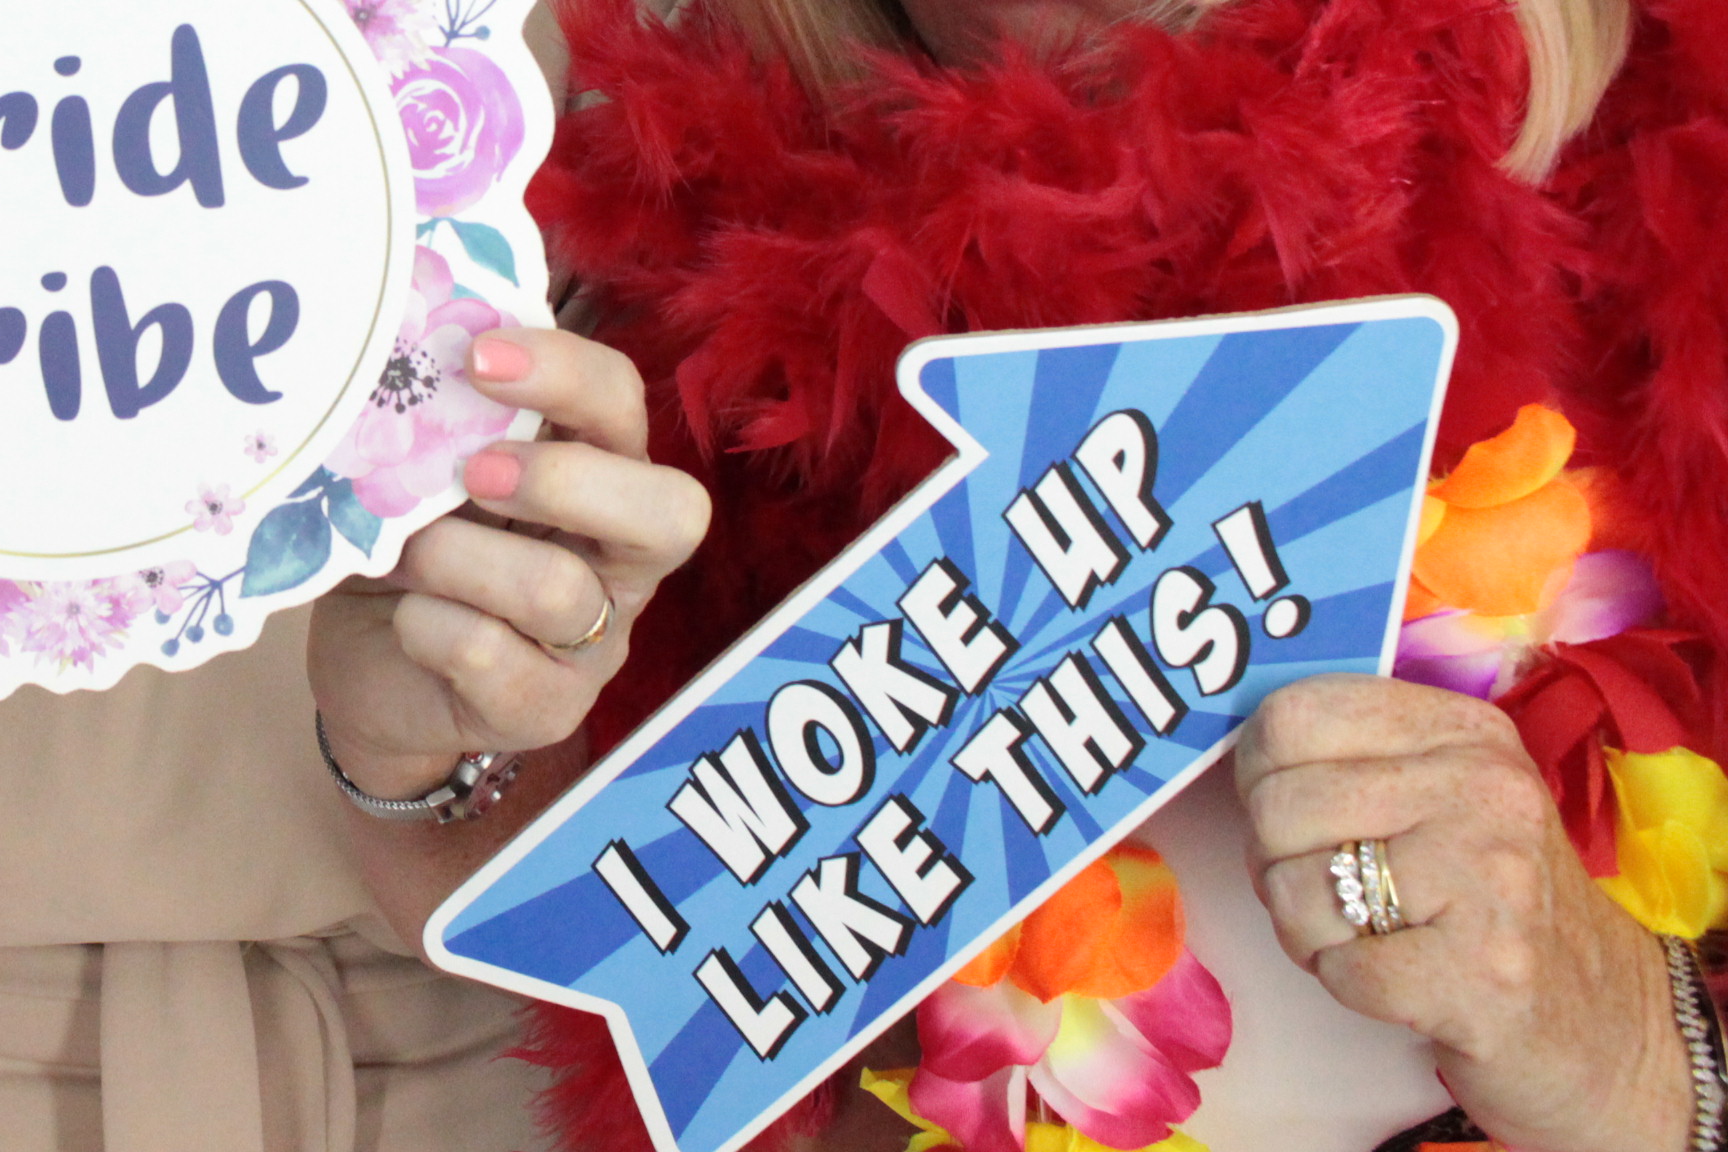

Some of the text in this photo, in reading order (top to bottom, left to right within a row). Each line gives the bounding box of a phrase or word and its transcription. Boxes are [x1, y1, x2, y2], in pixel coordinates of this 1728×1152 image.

[595, 408, 1171, 951] I WOKE UP
[694, 502, 1310, 1060] LIKE THIS!
